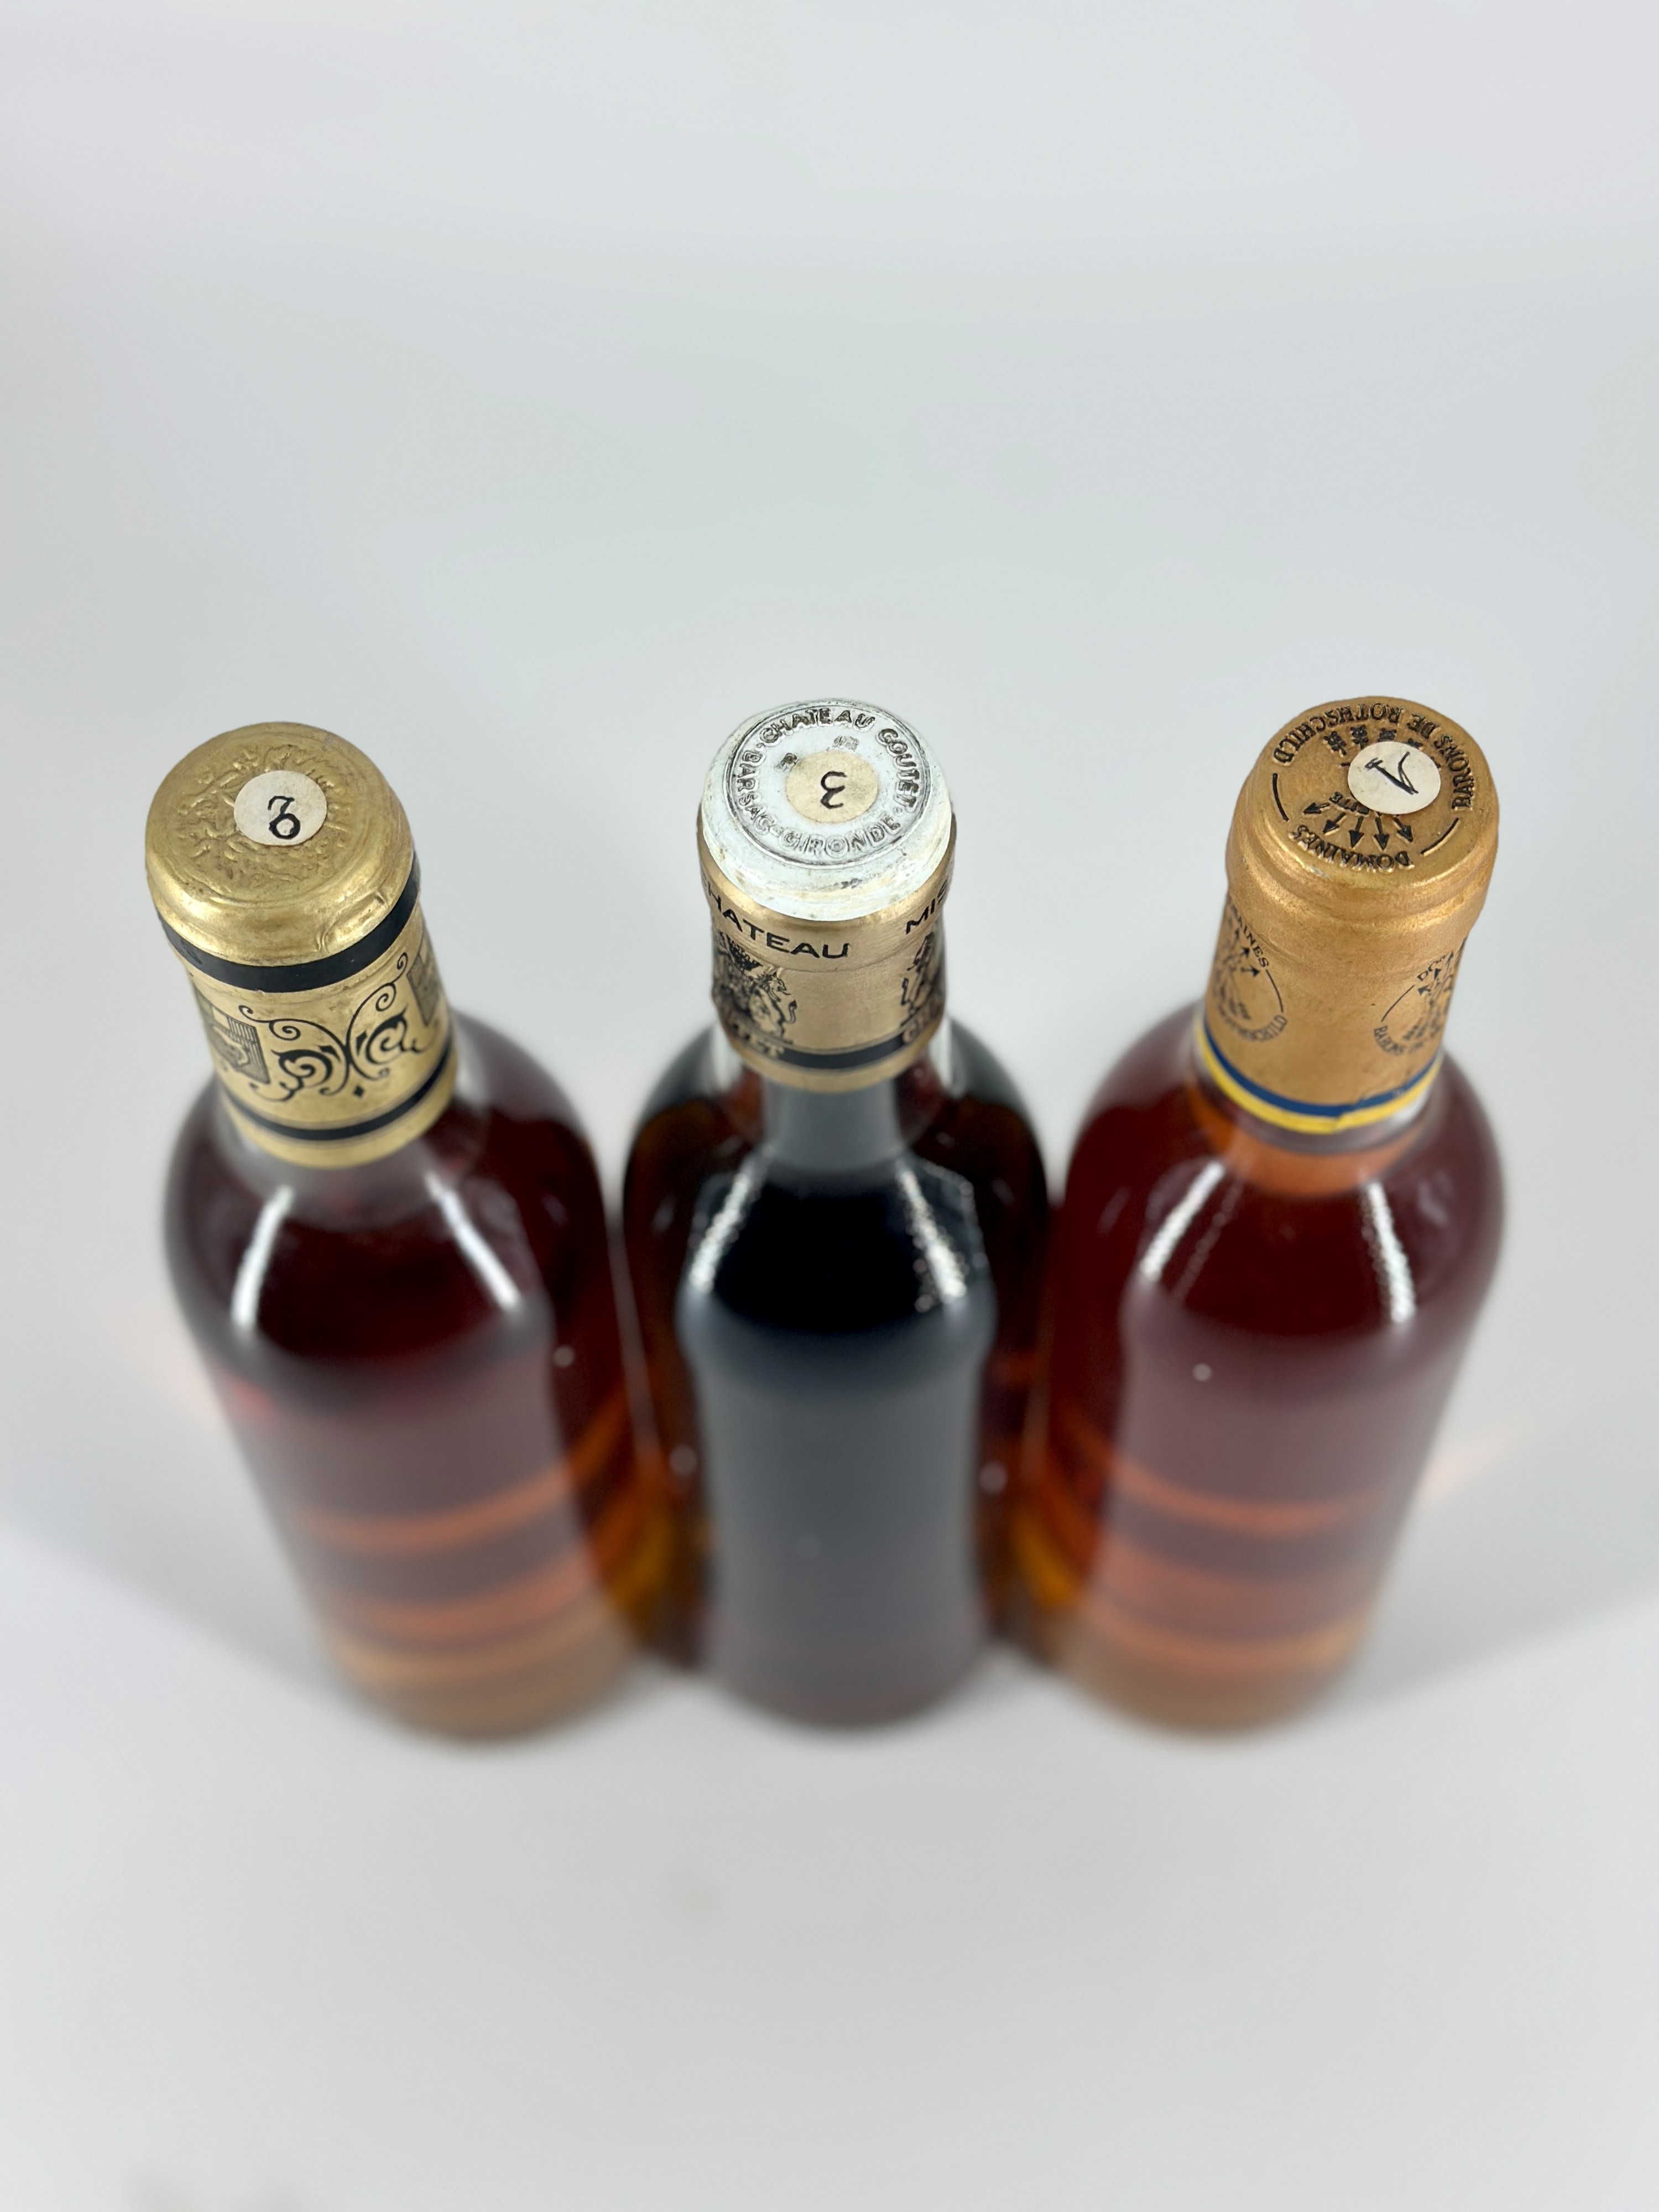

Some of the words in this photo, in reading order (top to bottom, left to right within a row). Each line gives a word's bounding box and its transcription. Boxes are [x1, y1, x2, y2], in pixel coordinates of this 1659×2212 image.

[760, 708, 875, 745] CHATEAU
[877, 728, 920, 812] COUTET
[1274, 703, 1404, 764] ROTHSCHILD
[1407, 714, 1439, 739] DE
[1434, 734, 1474, 811] BARONS
[1288, 825, 1414, 872] DOMAINES
[704, 874, 851, 959] HATEAU
